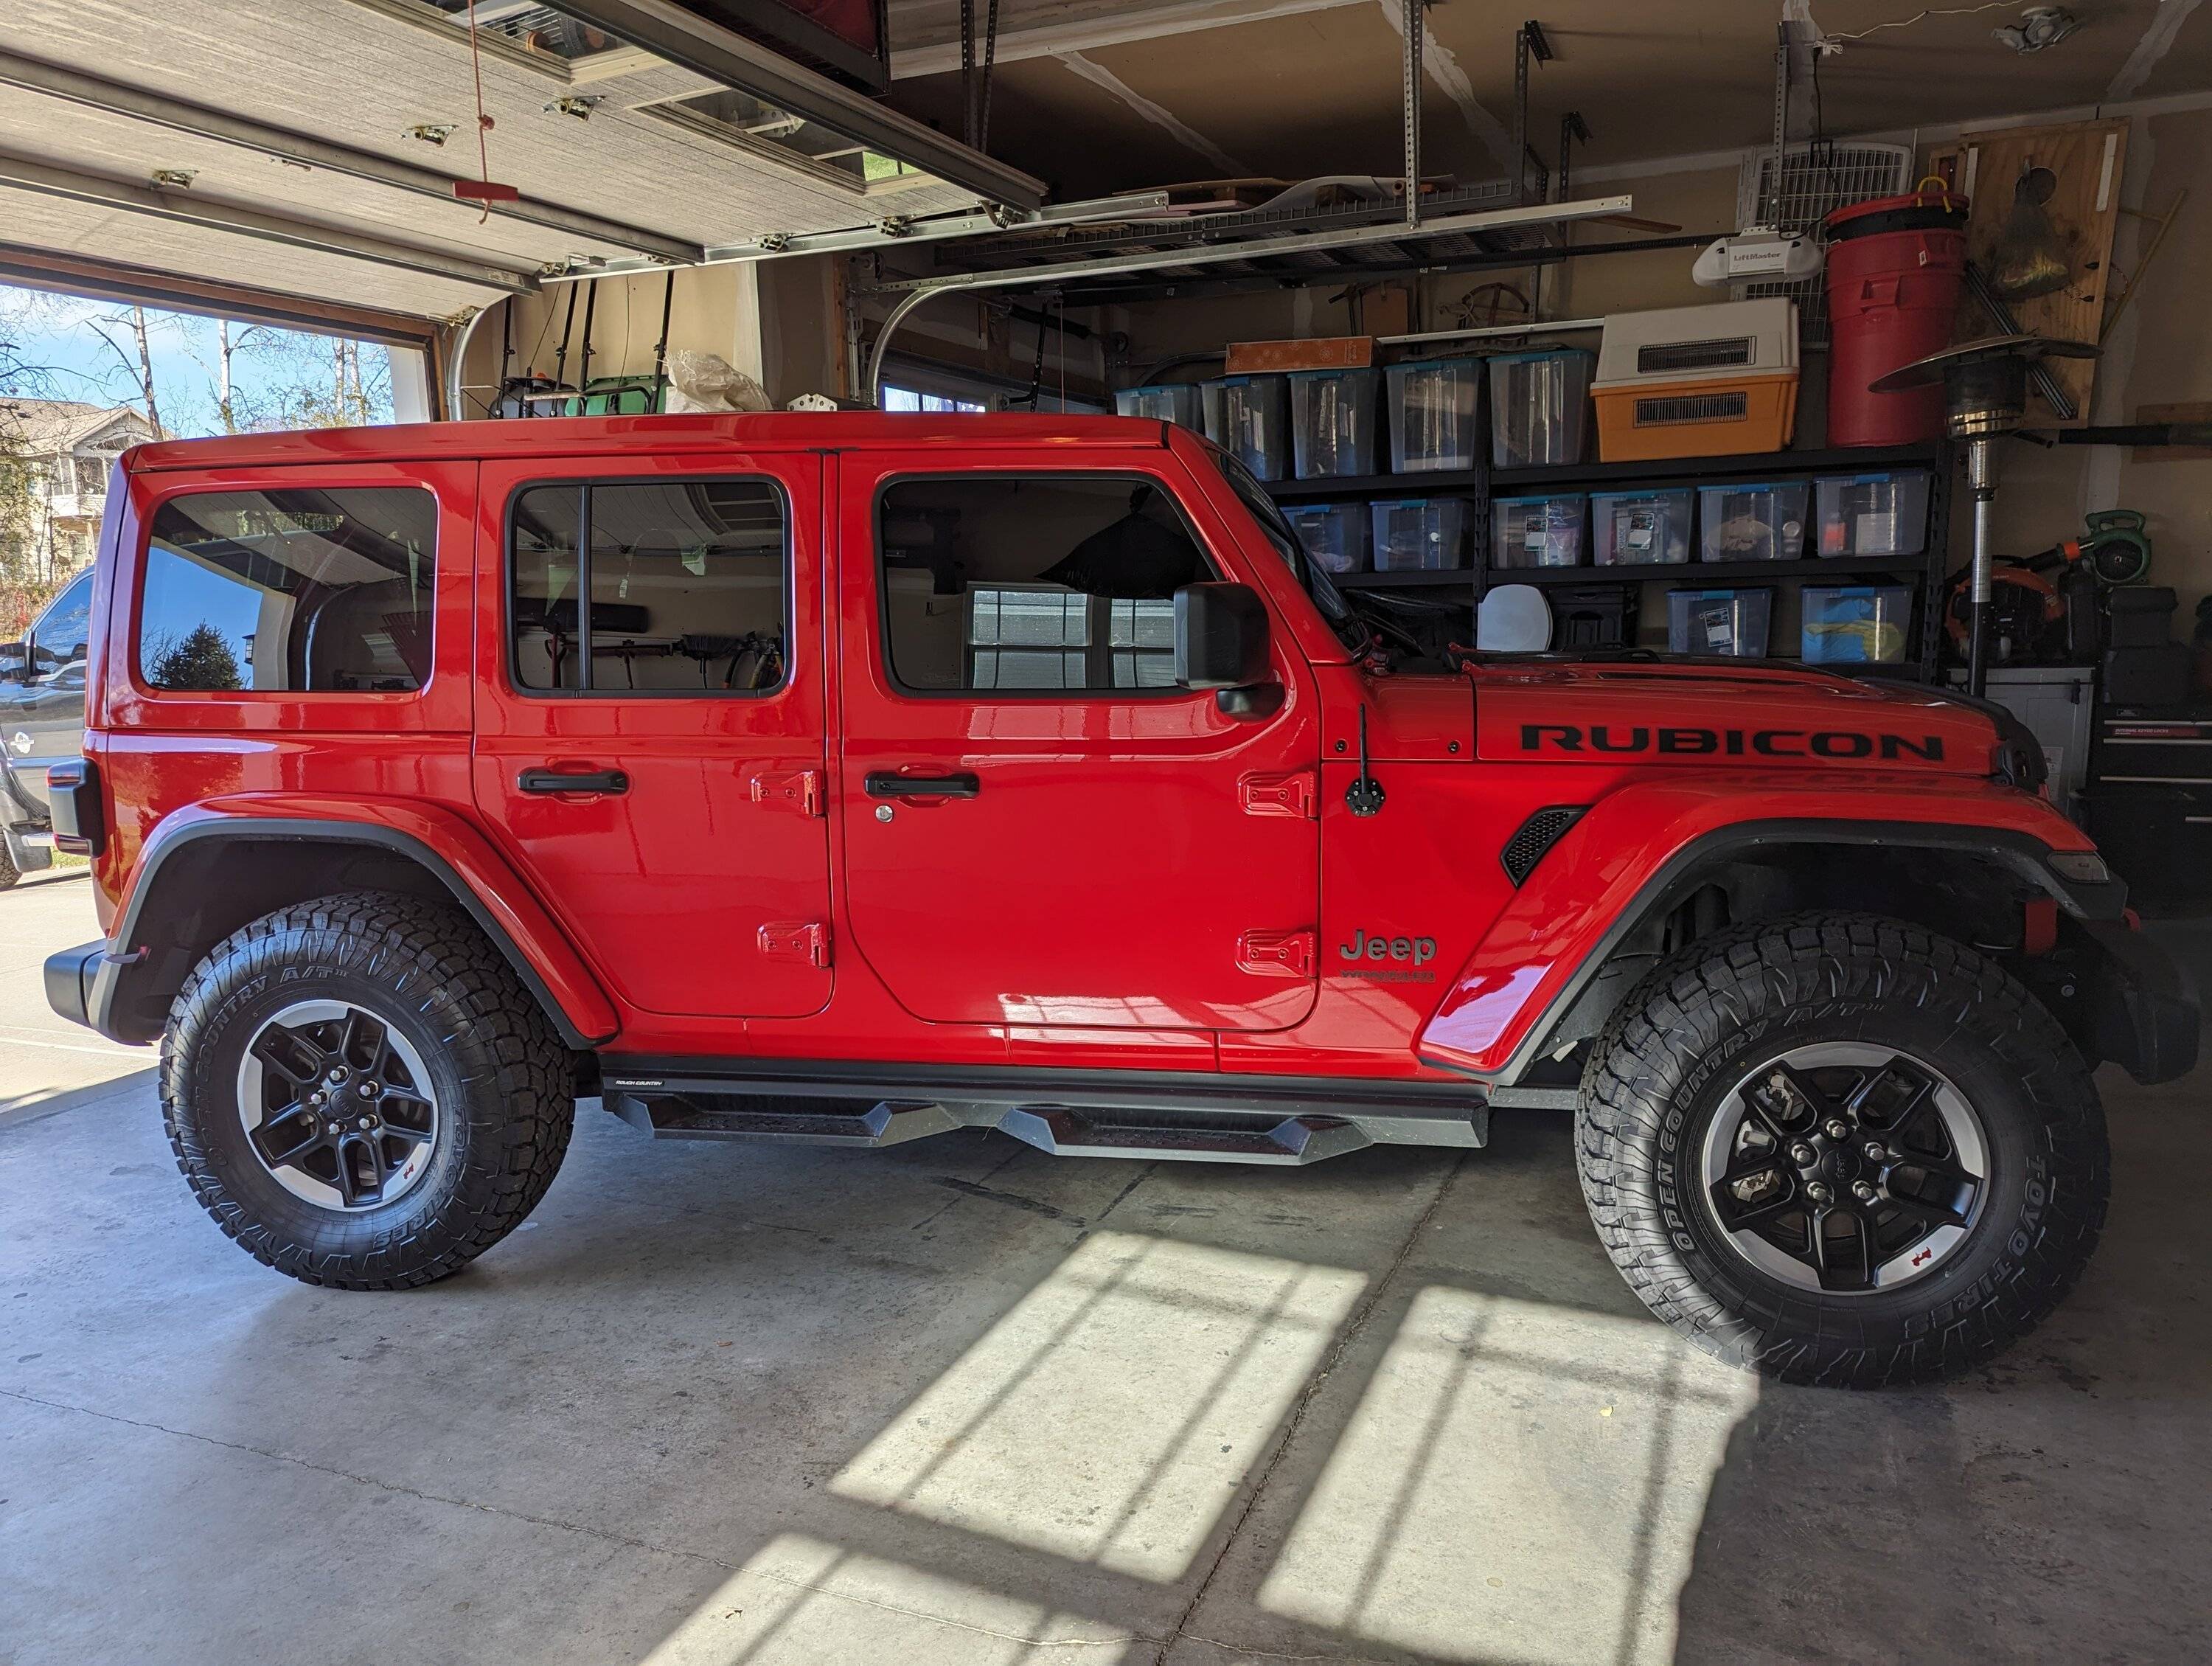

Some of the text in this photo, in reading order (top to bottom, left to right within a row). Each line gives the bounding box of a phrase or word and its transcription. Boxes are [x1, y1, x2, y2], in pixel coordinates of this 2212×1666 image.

[1733, 252, 1781, 261] LiftMaster
[1520, 724, 1944, 761] RUBICON
[1340, 929, 1437, 966] Jeep
[195, 975, 268, 1082] COUNTRY
[1660, 1018, 1770, 1153] COUNTRY
[1658, 1159, 1695, 1252] OPEN
[2007, 1154, 2047, 1257] TOYO
